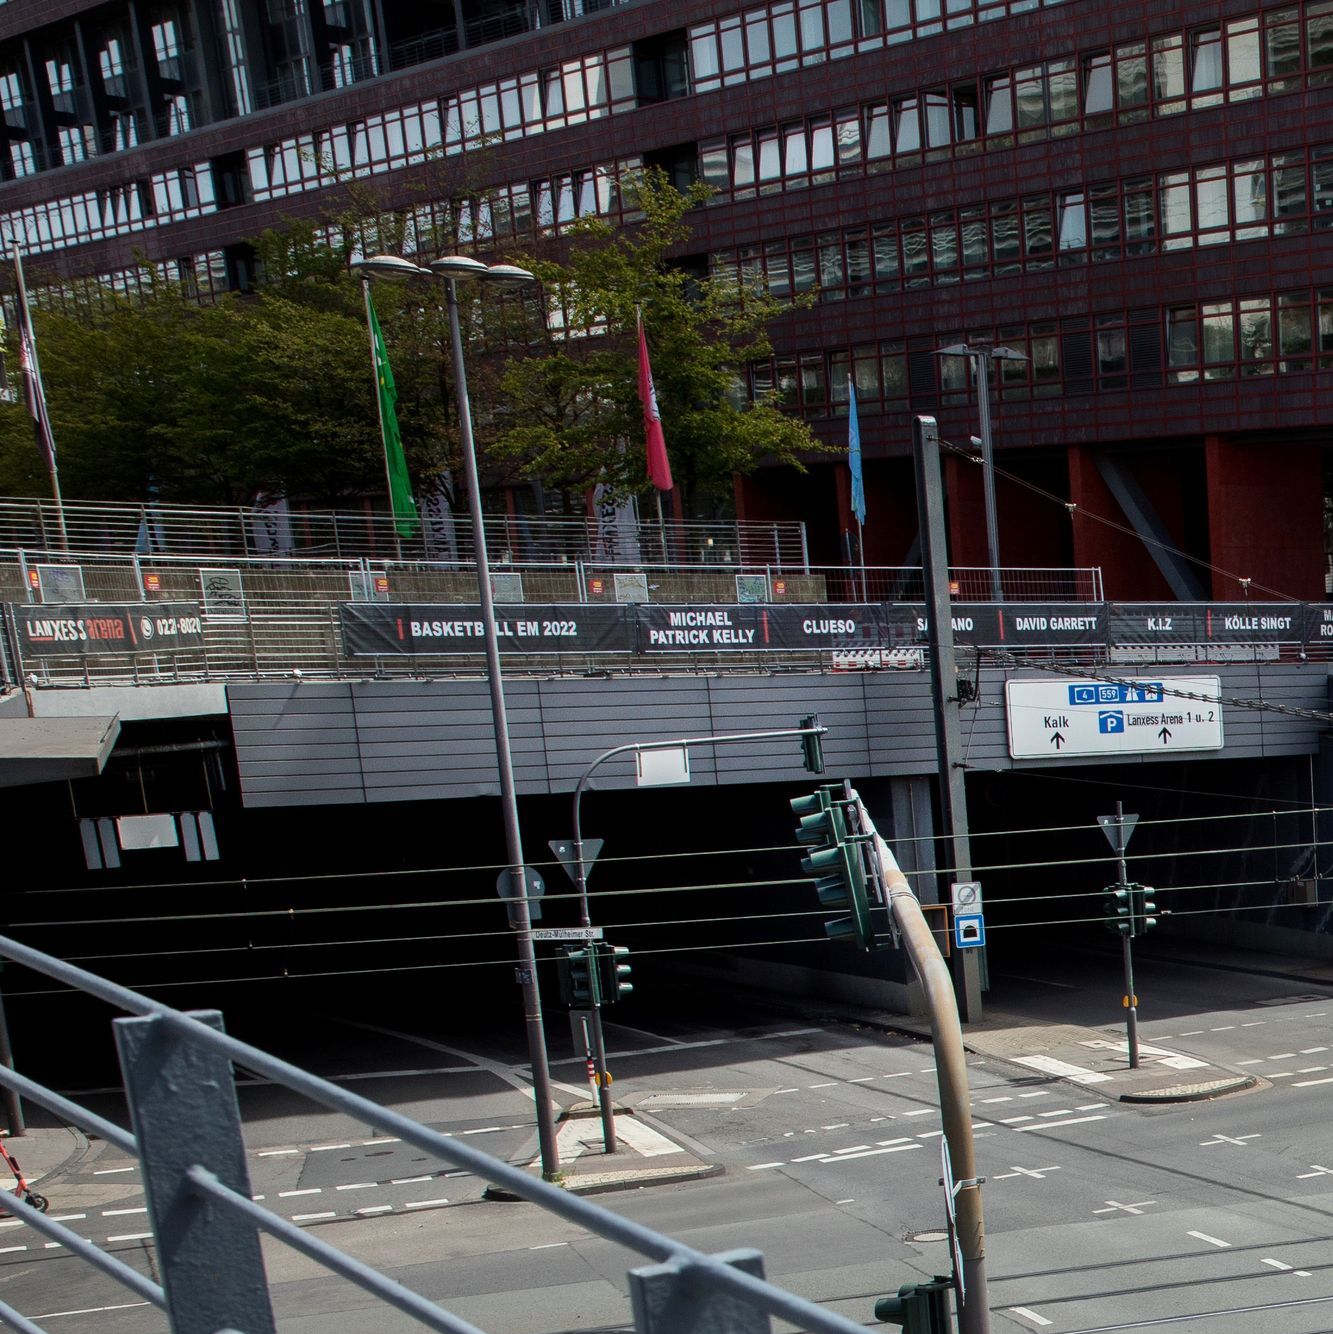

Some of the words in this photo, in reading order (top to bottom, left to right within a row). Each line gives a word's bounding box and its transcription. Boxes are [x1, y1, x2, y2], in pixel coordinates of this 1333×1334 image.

[669, 611, 733, 627] MICHAEL
[803, 619, 855, 634] CLUESO
[1016, 617, 1047, 631] DAVID
[1050, 616, 1097, 630] GARRETT
[1225, 614, 1259, 630] KÖLLE
[1260, 617, 1292, 629] SINGT
[26, 619, 88, 641] LANXESS
[87, 618, 124, 640] arena
[411, 621, 514, 637] BASKETBLL
[517, 622, 539, 636] EM
[543, 621, 577, 636] 2022
[650, 629, 710, 645] PATRICK
[712, 628, 756, 645] KELLY
[1082, 689, 1088, 699] 4
[1101, 690, 1116, 699] 559
[1044, 716, 1069, 729] Kalk
[1127, 714, 1159, 726] Lanxess
[1161, 713, 1183, 725] Arena
[1187, 712, 1192, 723] 1
[1195, 713, 1205, 723] u.
[1208, 711, 1215, 722] 2
